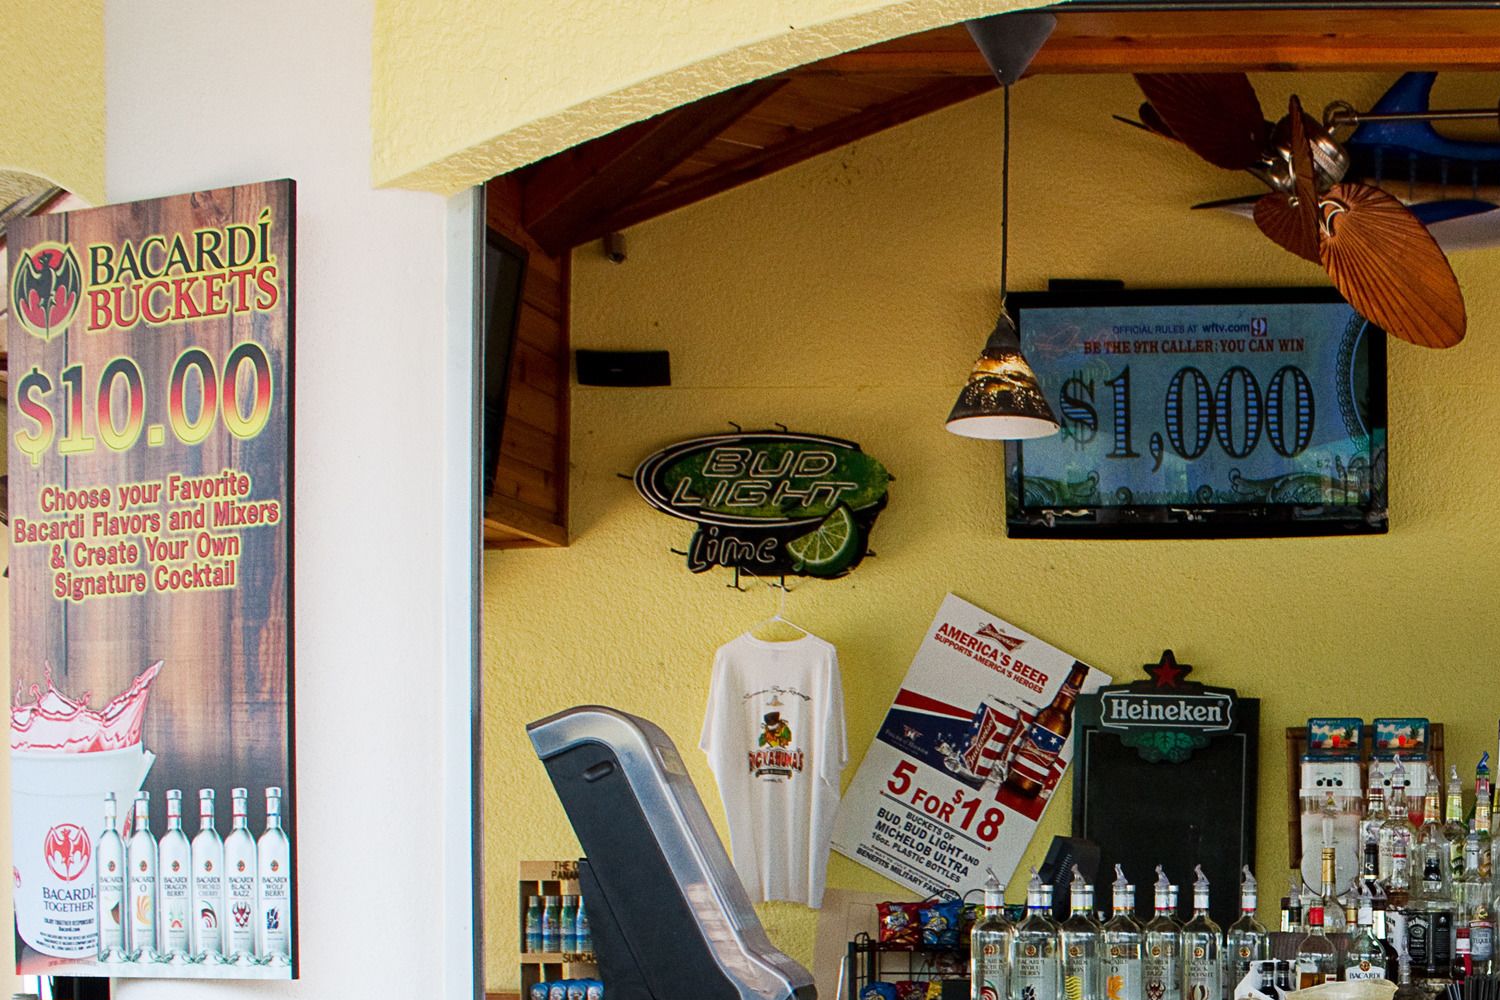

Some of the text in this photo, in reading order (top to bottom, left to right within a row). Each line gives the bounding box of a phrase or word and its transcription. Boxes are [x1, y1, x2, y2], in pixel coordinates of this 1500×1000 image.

[88, 208, 272, 287] BACARDÍ
[87, 266, 278, 331] BUCKETS
[1083, 341, 1102, 355] BE
[1103, 340, 1132, 354] THE
[1133, 339, 1159, 354] 9TH
[1219, 338, 1246, 353] YOU
[1248, 338, 1275, 352] CAN
[1277, 337, 1305, 352] WIN
[1112, 325, 1152, 336] OFFICIAL
[1155, 325, 1185, 335] RULES
[1186, 324, 1198, 334] AT
[1201, 322, 1250, 334] wftv.com
[15, 342, 273, 465] $10.00
[1060, 364, 1316, 474] $1,000
[702, 447, 837, 478] BUD
[40, 471, 250, 513] Choose your Favorite
[671, 477, 858, 508] LIGHT
[14, 501, 279, 543] Bacardi Flavors and Mixers
[50, 532, 240, 569] & Create Your Own
[54, 560, 235, 601] Signature Cocktail
[934, 633, 973, 657] SUPPORTS
[972, 653, 1013, 678] AMERICA'S
[1013, 672, 1044, 694] HEROES
[938, 623, 1012, 667] AMERICA'S
[1012, 659, 1049, 686] BEER
[1110, 699, 1223, 722] Heineken
[887, 759, 1005, 842] 5 FOR $18
[903, 821, 928, 840] BUD
[928, 835, 963, 858] LIGHT
[962, 853, 980, 867] AND
[905, 811, 955, 841] BUCKETS OF
[553, 861, 571, 871] THE
[856, 847, 890, 868] BENEFITS
[890, 864, 924, 886] MILITARY
[874, 821, 969, 877] MICHELOB ULTRA
[892, 843, 925, 864] PLASTIC
[925, 860, 962, 884] BOTTLES
[44, 901, 94, 913] TOGETHER
